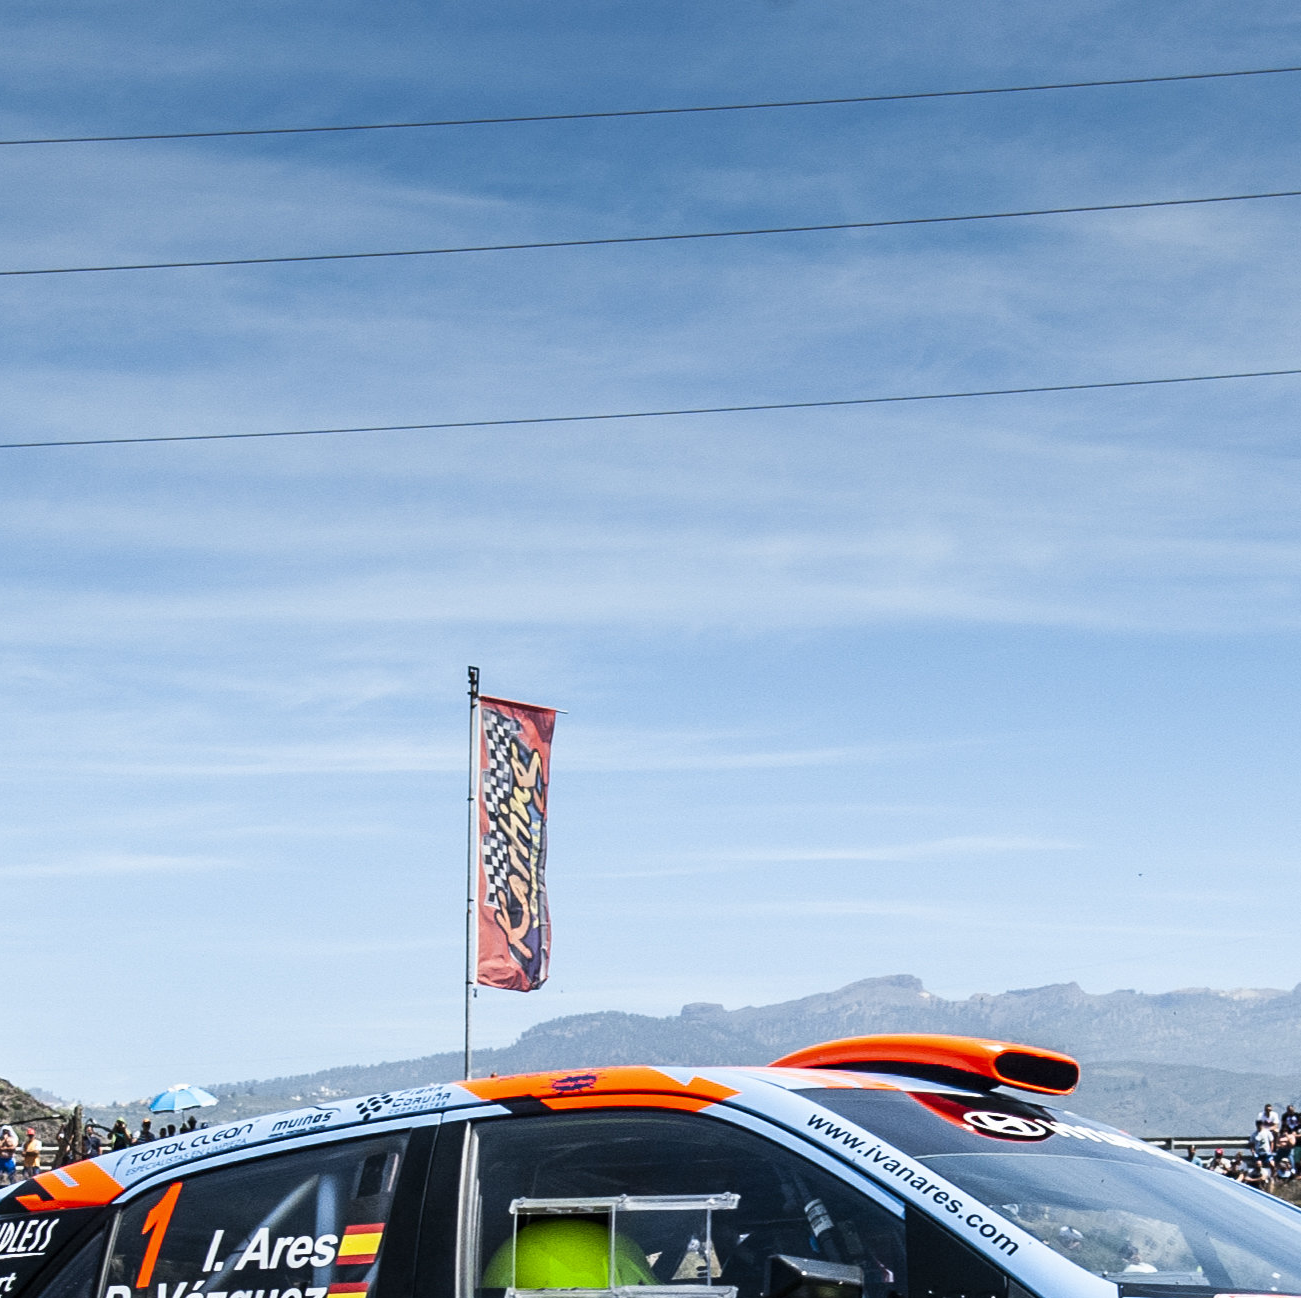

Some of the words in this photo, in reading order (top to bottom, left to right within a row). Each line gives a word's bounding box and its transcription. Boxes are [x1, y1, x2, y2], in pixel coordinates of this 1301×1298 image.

[496, 742, 544, 959] Karting
[135, 1182, 183, 1288] 1
[807, 1114, 1019, 1257] www.ivanares.com
[202, 1230, 225, 1272] I.
[234, 1227, 338, 1271] Ares
